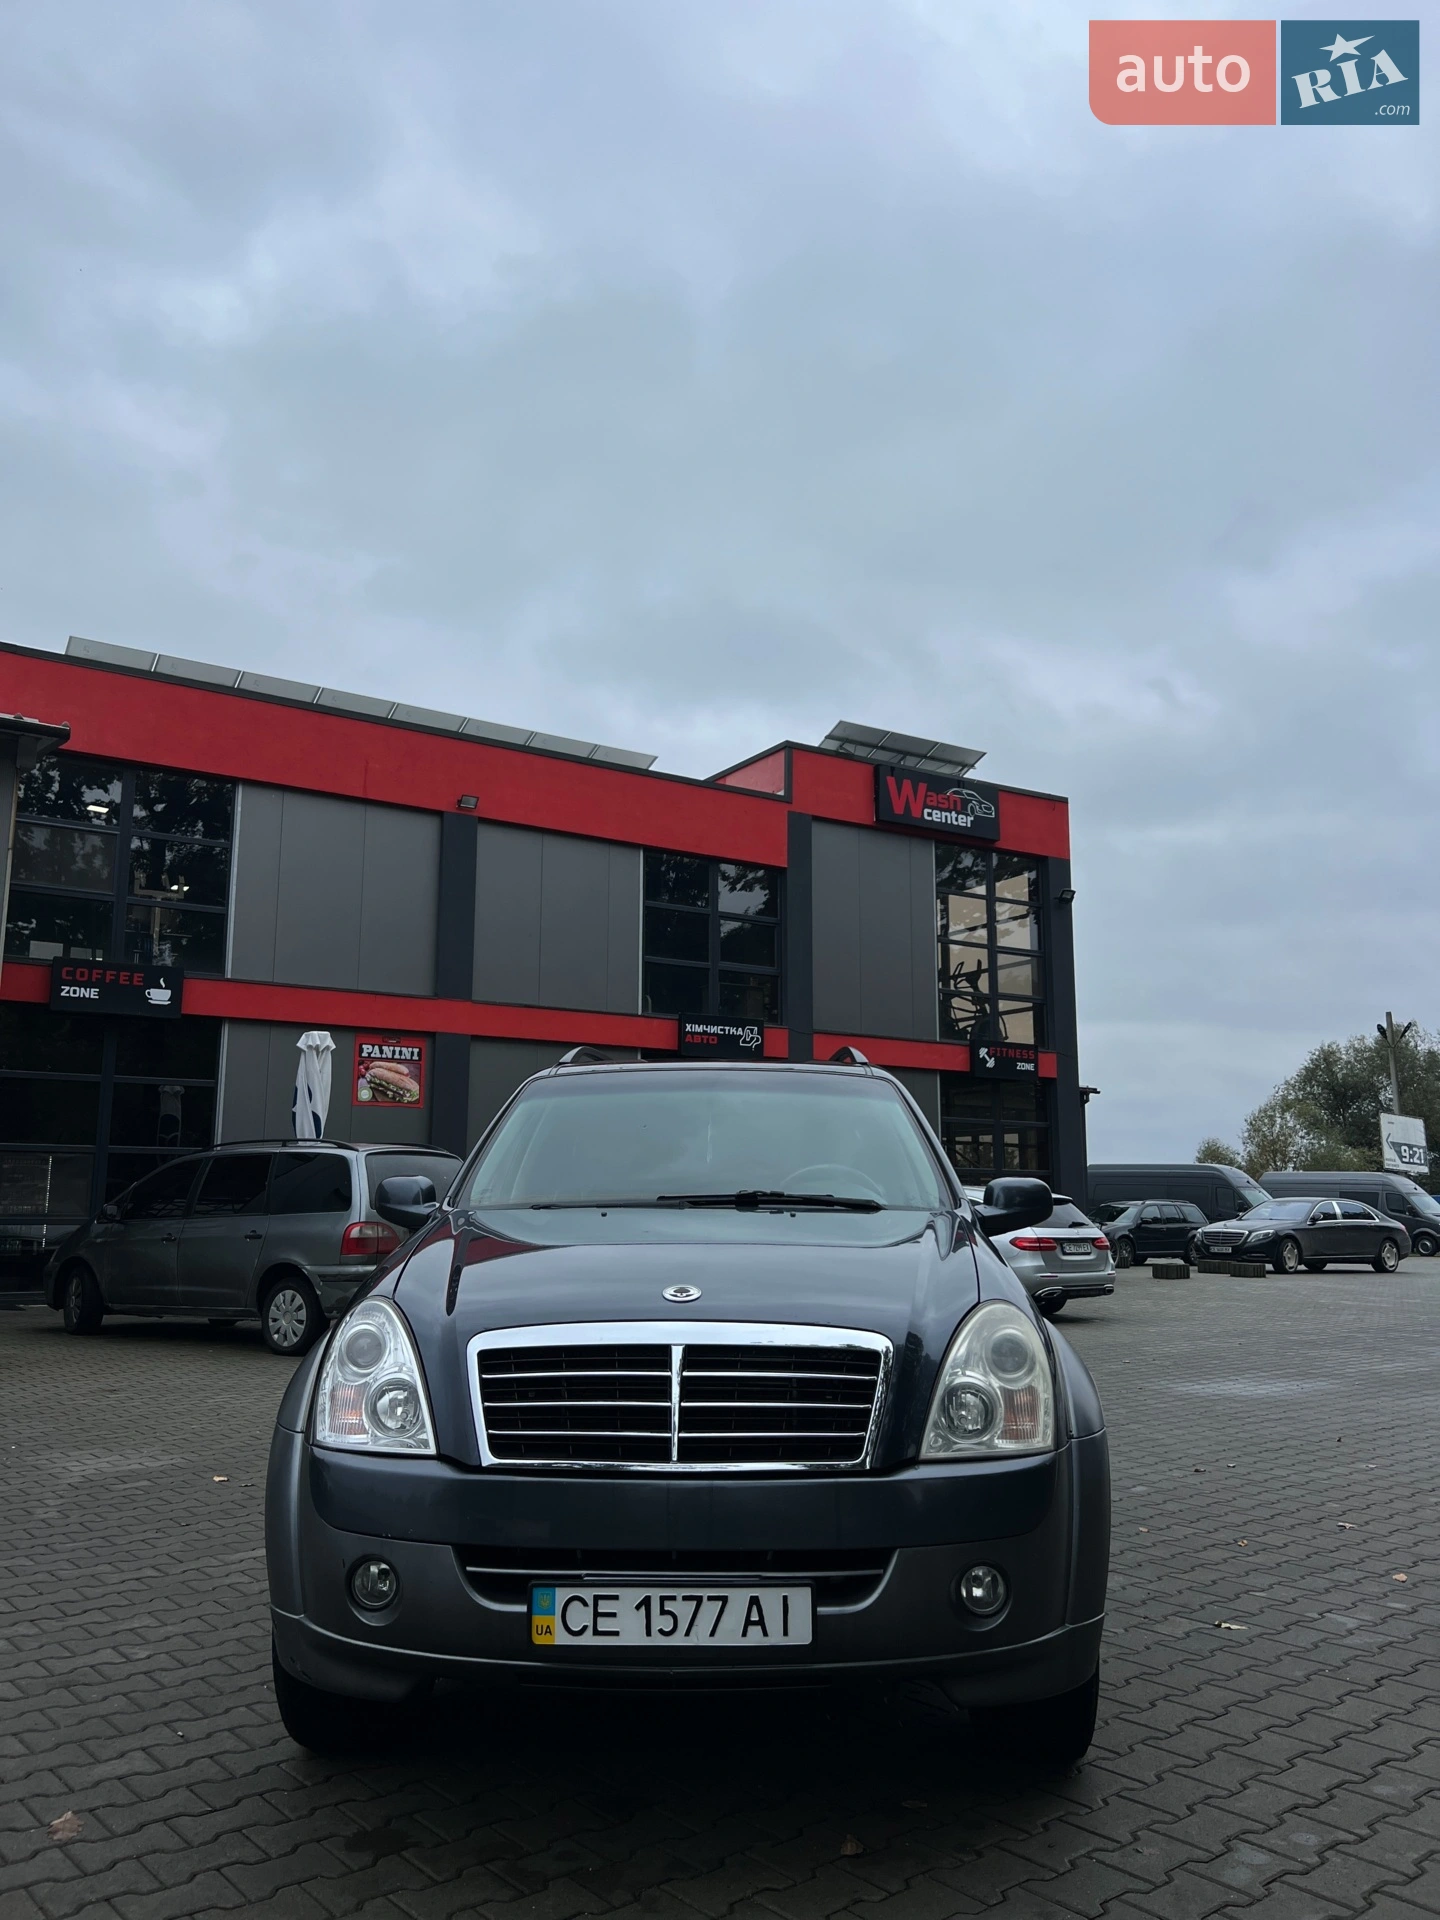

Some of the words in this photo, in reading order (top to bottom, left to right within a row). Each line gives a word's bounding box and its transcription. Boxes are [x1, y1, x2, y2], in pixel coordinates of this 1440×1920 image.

[886, 775, 962, 818] Wash
[923, 808, 974, 828] center
[61, 966, 145, 986] COFFEE
[60, 985, 100, 999] ZONE
[685, 1023, 744, 1036] ХІМЧИСТКА
[685, 1033, 718, 1045] АВТО
[361, 1044, 420, 1061] PANINI
[989, 1046, 1035, 1060] FITNESS
[1016, 1062, 1035, 1071] ZONE
[561, 1594, 620, 1638] CE
[634, 1594, 728, 1638] 1577
[741, 1594, 789, 1638] AI
[535, 1624, 553, 1637] UA
